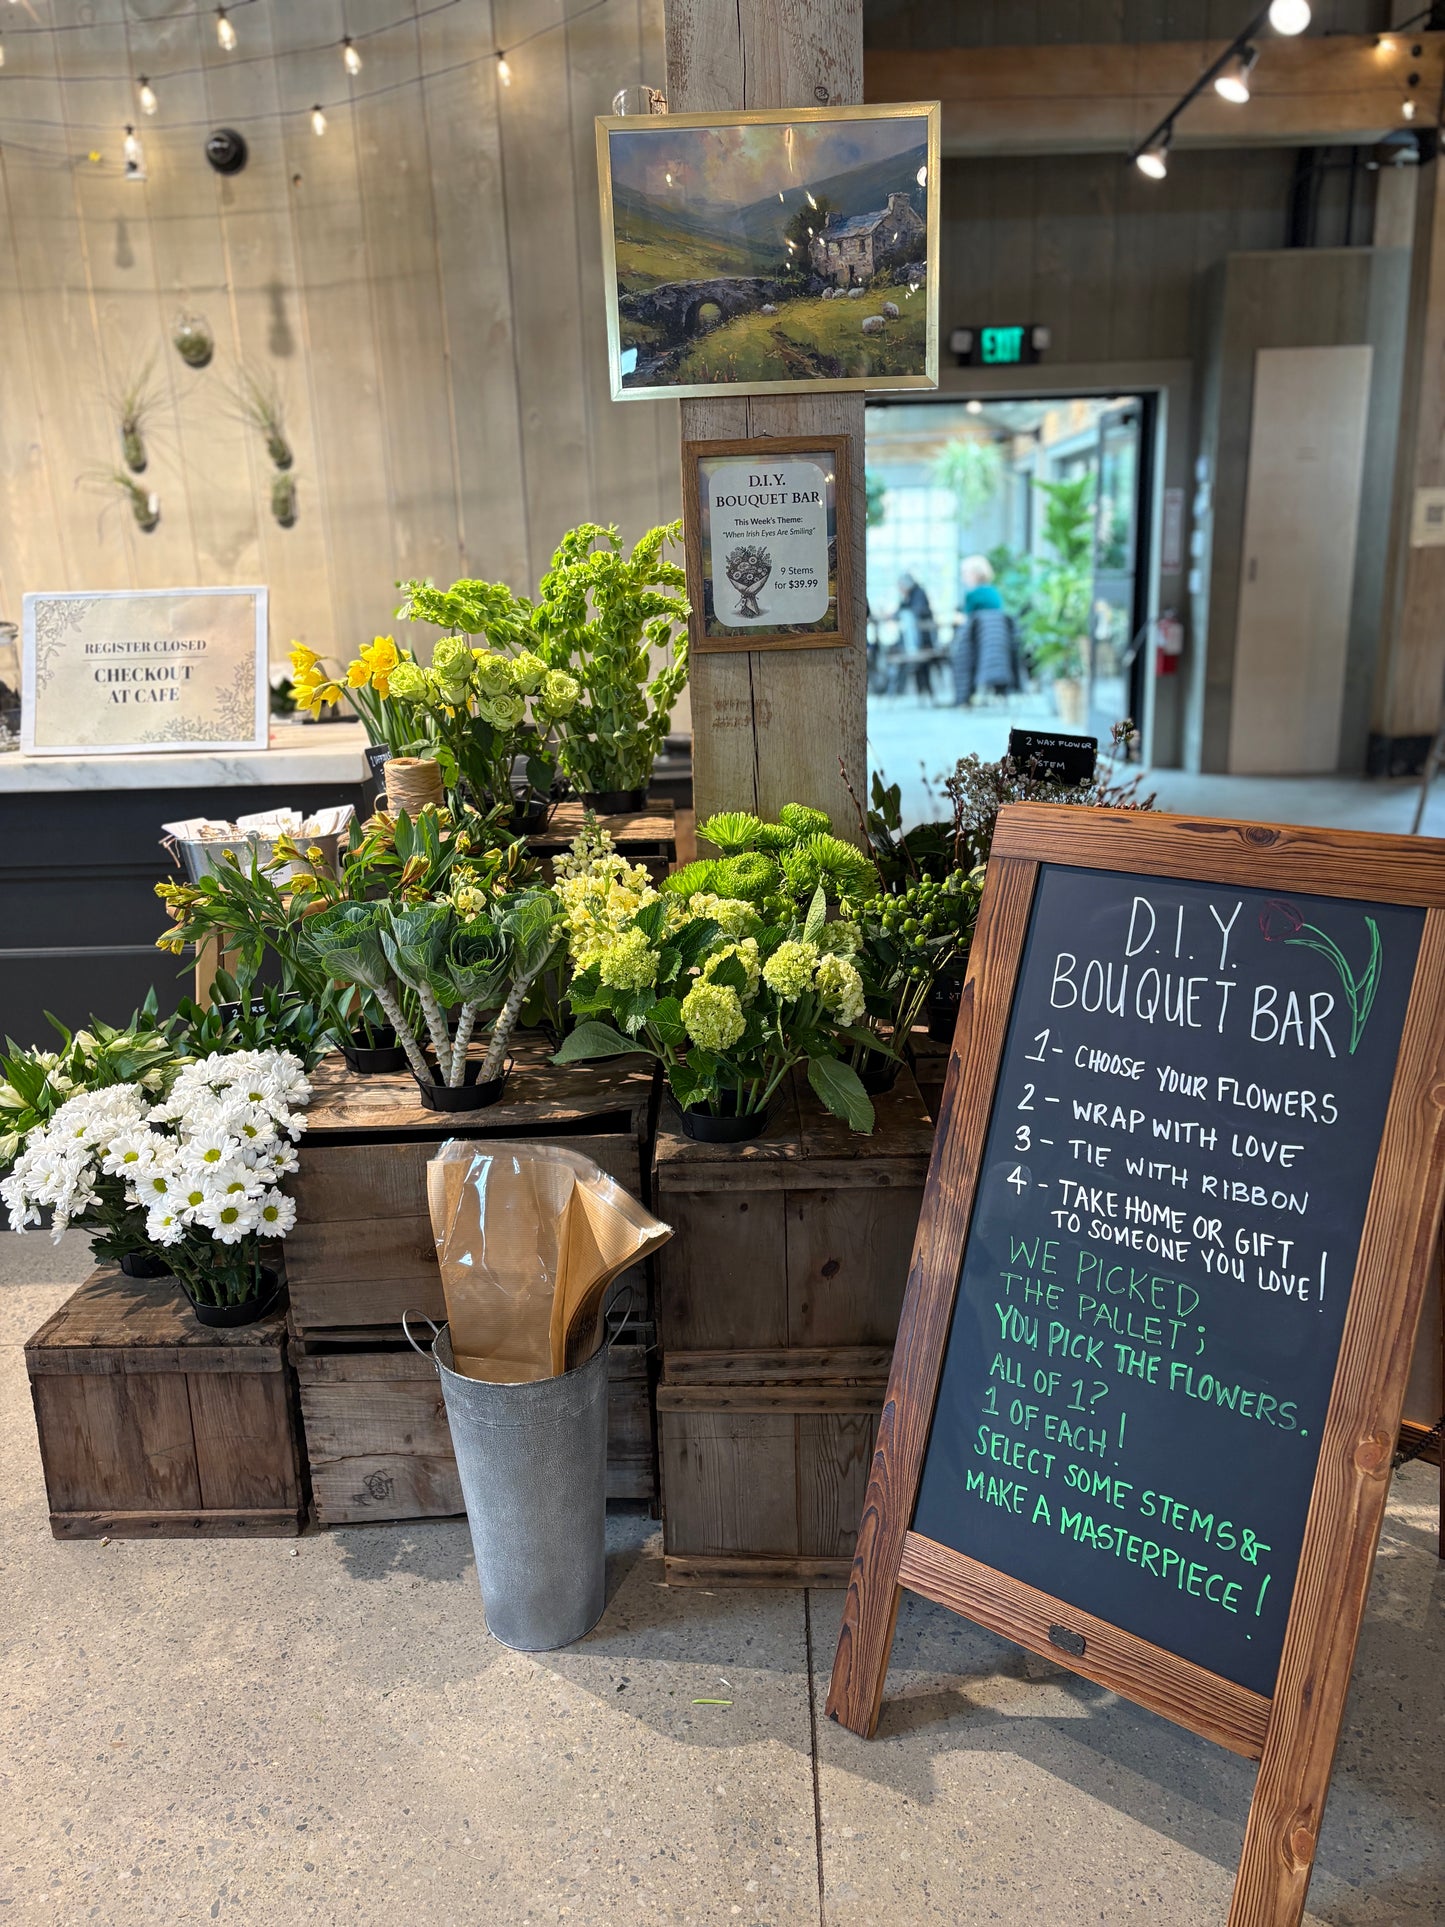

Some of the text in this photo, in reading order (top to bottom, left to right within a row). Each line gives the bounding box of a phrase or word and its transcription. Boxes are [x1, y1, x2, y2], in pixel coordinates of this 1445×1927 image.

[716, 491, 820, 508] BOUQUET BAR
[749, 473, 786, 488] D.I.Y.
[734, 516, 803, 526] This Week's Theme:
[746, 529, 760, 538] Irish
[761, 529, 776, 539] Eyes
[777, 528, 788, 536] Are
[774, 579, 818, 590] for $39.99
[780, 566, 814, 576] 9 Stems
[85, 639, 207, 655] REGISTER CLOSED
[94, 665, 194, 683] CHECKOUT
[108, 687, 180, 705] AT CAFE
[1026, 736, 1032, 746] 2
[1058, 740, 1092, 749] FLOWER
[1037, 760, 1065, 770] STEM
[1125, 896, 1243, 970] D.I.Y.
[1050, 953, 1337, 1058] BOUQUET BAR
[1074, 1045, 1145, 1080] CHOOSE
[1156, 1065, 1208, 1100] YOUR
[1218, 1077, 1338, 1124] FLOWERS
[1073, 1100, 1145, 1133] WRAP
[1153, 1118, 1218, 1151] WITH
[1232, 1134, 1304, 1168] LOVE
[1068, 1139, 1112, 1168] TIE
[1125, 1157, 1188, 1189] WITH
[1202, 1174, 1309, 1215] RIBBON
[1050, 1210, 1080, 1233] TO
[1088, 1219, 1192, 1263] SOMEONE
[1200, 1248, 1245, 1283] YOU
[1058, 1179, 1118, 1218] TAKE
[1125, 1195, 1187, 1234] HOME
[1193, 1216, 1224, 1248] OR
[1235, 1228, 1294, 1269] GIFT
[1000, 1272, 1065, 1310] THE
[1009, 1236, 1201, 1318] WE PICKED
[989, 1352, 1109, 1415] ALL OF 1?
[995, 1302, 1308, 1437] YOU PICK THE FLOWERS.
[981, 1386, 1000, 1416] 1
[1009, 1399, 1040, 1431] OF
[973, 1424, 1056, 1479] SELECT
[1064, 1463, 1134, 1510] SOME
[966, 1469, 1028, 1514] MAKE
[1031, 1494, 1052, 1526] A
